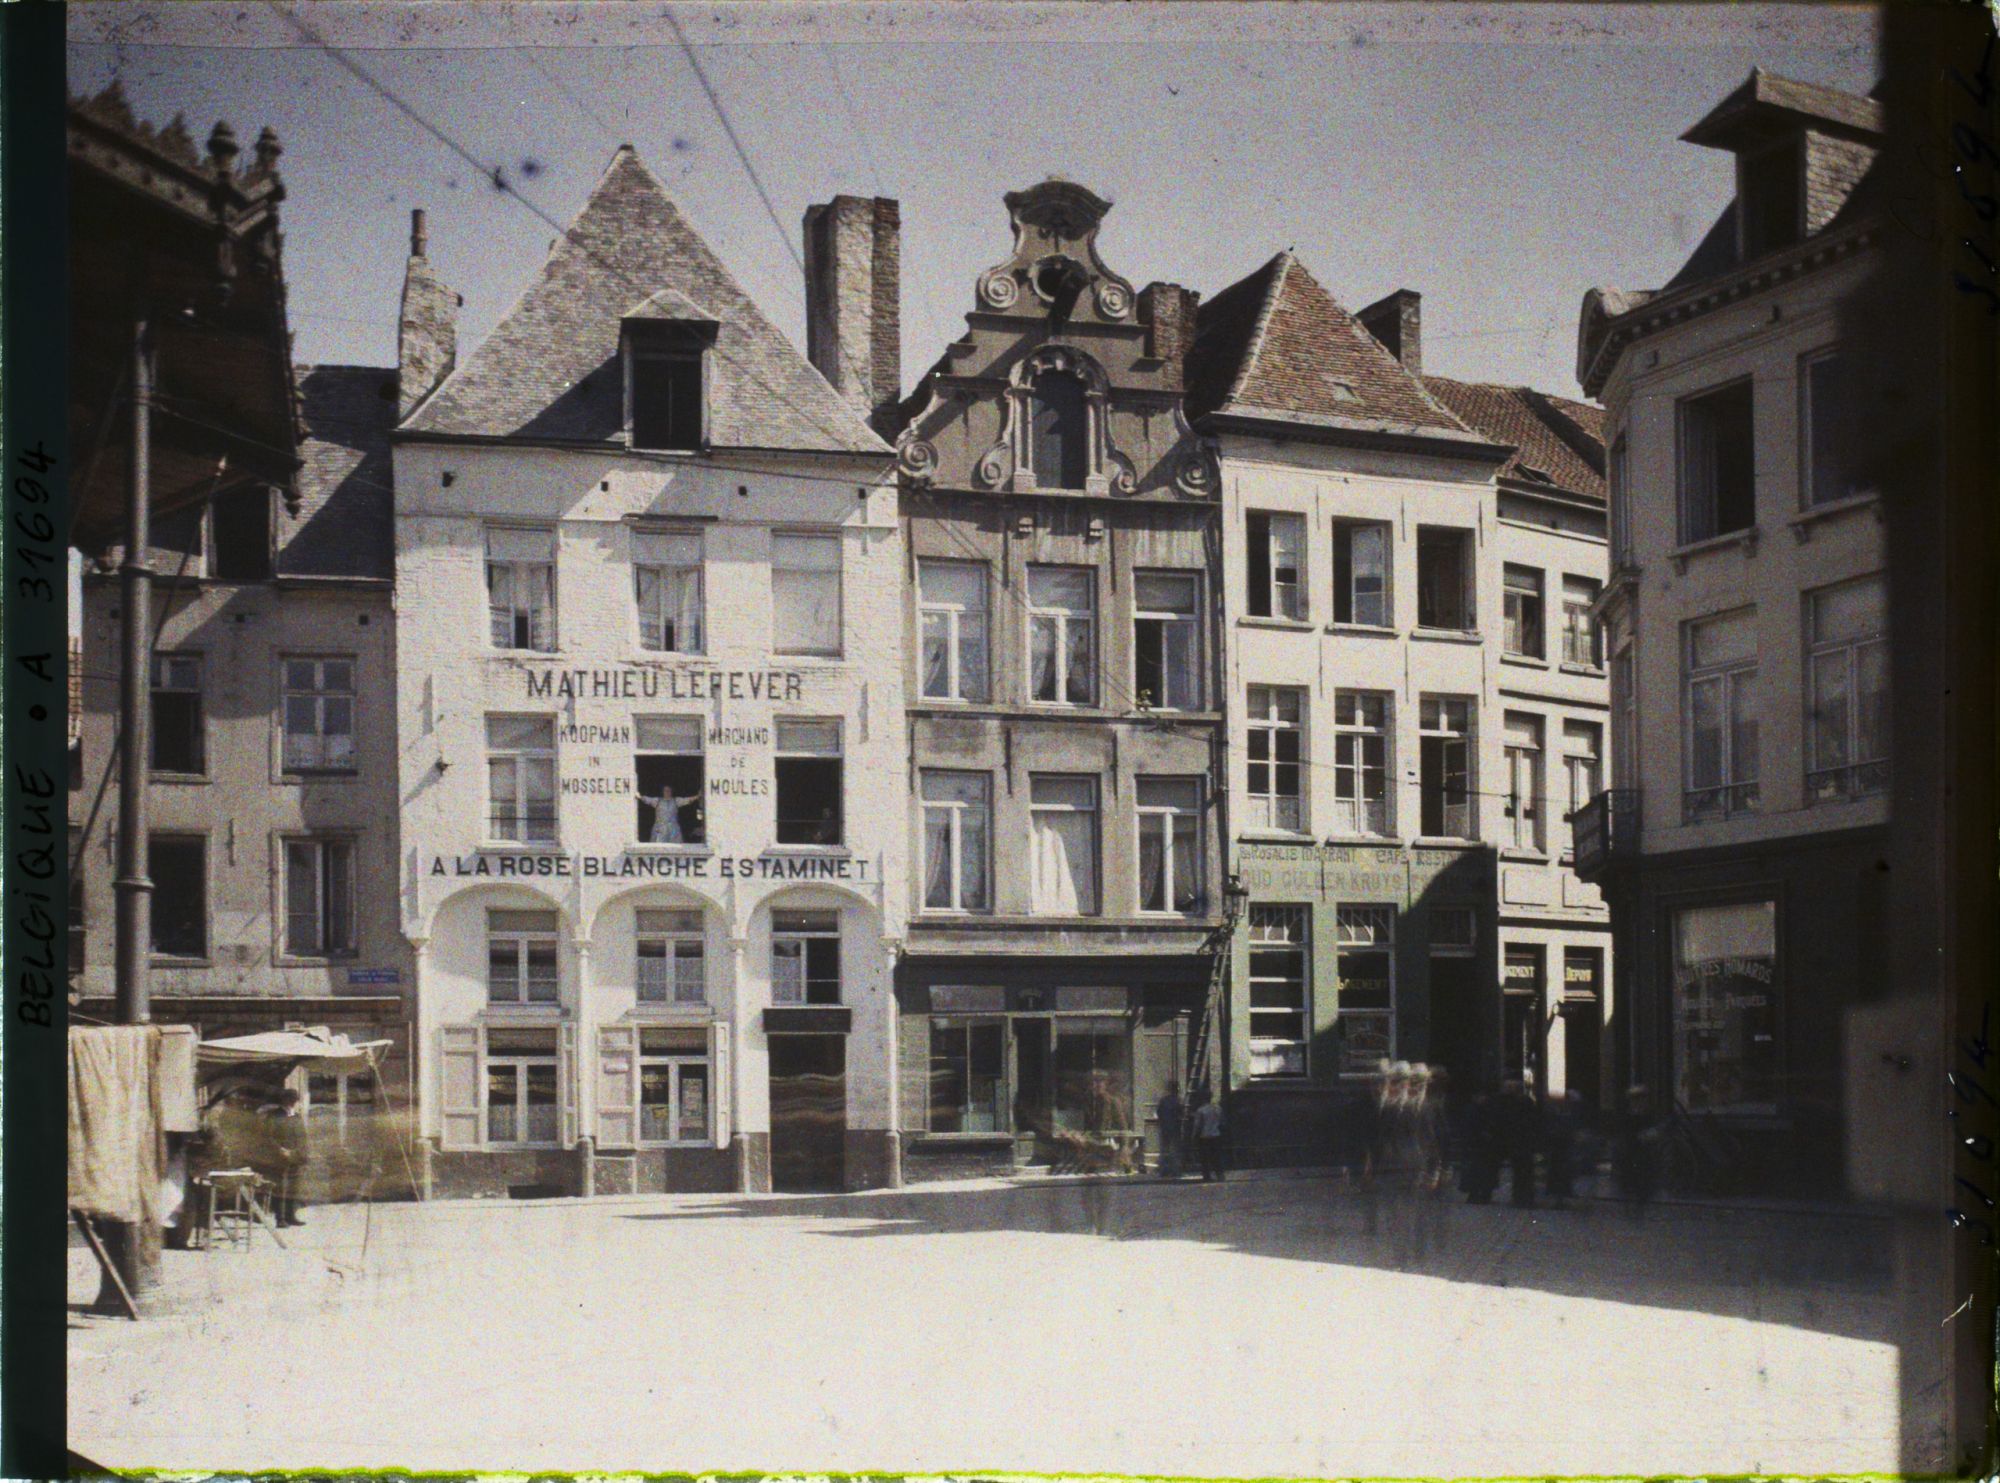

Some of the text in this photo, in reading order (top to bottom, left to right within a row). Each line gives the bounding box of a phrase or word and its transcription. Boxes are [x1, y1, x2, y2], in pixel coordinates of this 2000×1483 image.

[15, 440, 57, 602] 31694
[17, 651, 53, 682] A
[526, 670, 803, 700] MATHIEU LEFEVER
[559, 725, 631, 745] KOOPMAN
[708, 727, 769, 746] MARCHAND
[588, 757, 601, 766] IN
[730, 757, 746, 769] DE
[561, 777, 631, 794] MOSSELEN
[710, 779, 769, 796] MOULES
[431, 856, 869, 879] A LA ROSE BLANCHE ESTAMINET
